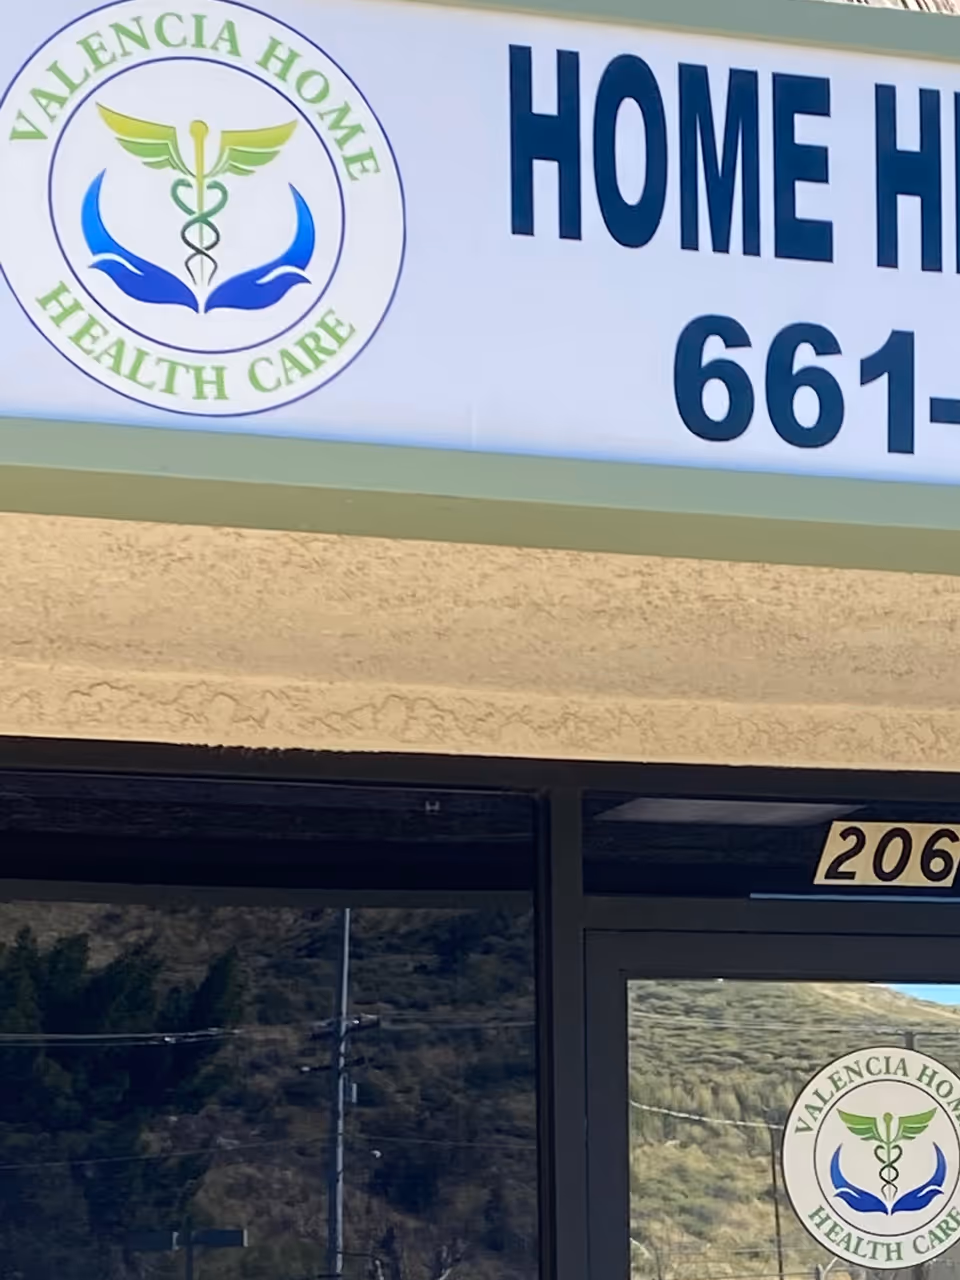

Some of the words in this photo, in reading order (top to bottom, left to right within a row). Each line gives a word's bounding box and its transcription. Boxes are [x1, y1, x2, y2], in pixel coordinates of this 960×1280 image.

[10, 12, 243, 146] VALENCIA
[255, 35, 382, 182] HOME
[508, 44, 835, 265] HOME
[34, 280, 229, 401] HEALTH
[246, 307, 357, 394] CARE
[824, 825, 960, 884] 206
[795, 1056, 910, 1136] VALENCIA
[808, 1205, 904, 1262] HEALTH
